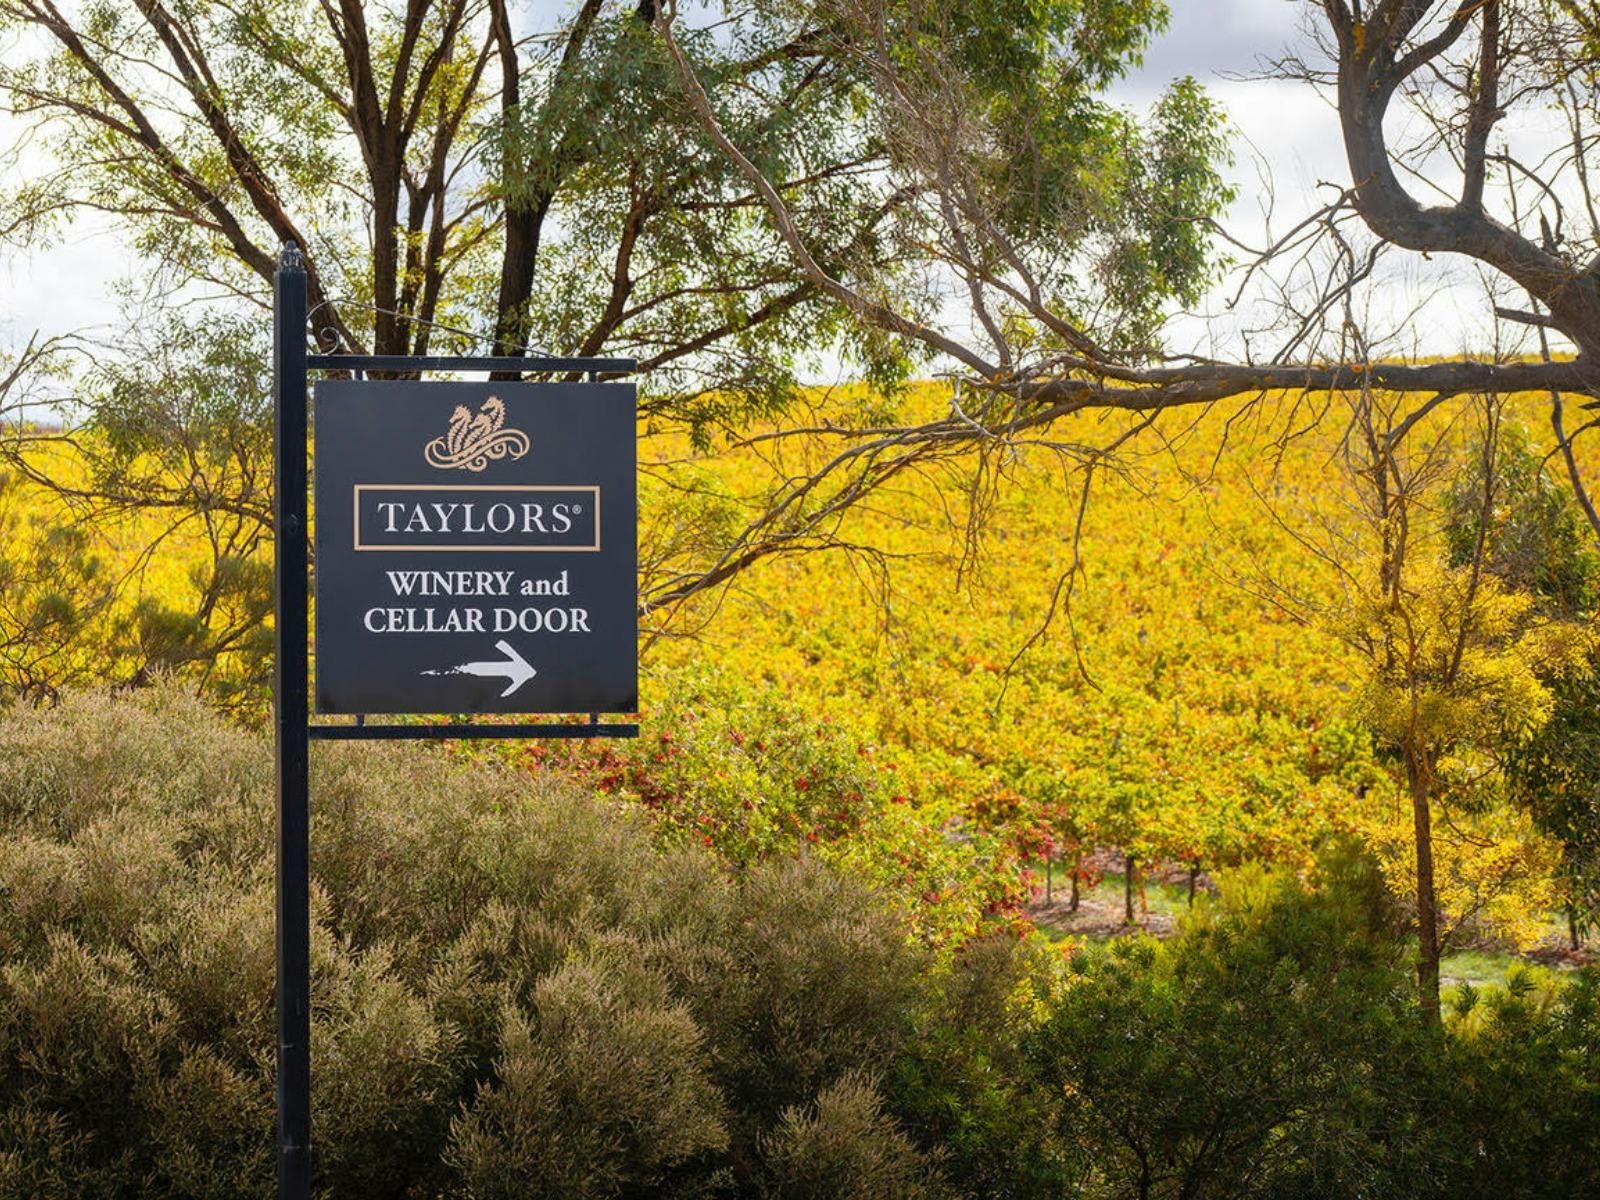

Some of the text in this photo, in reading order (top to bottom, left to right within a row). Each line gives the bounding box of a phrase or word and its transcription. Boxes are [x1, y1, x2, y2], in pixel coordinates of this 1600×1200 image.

[385, 570, 570, 596] WINERY and
[364, 608, 591, 633] CELLAR DOOR
